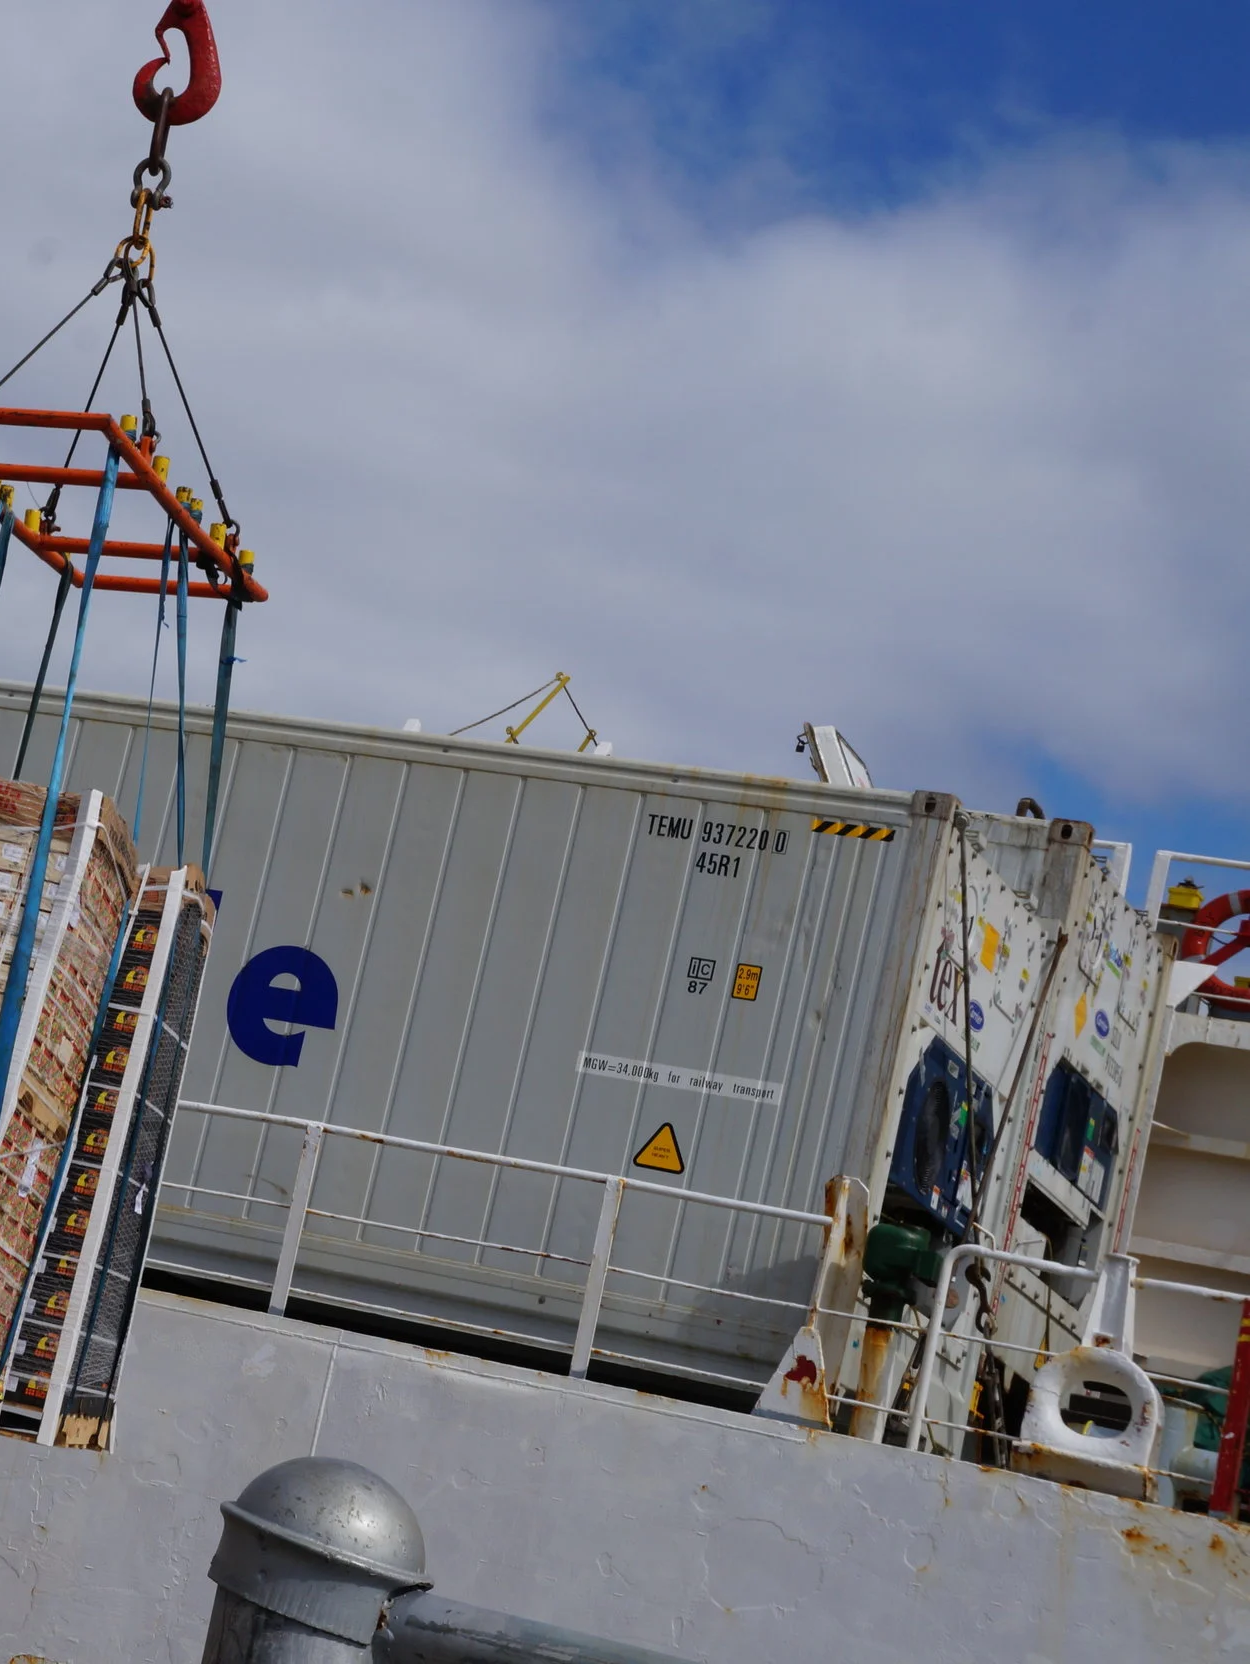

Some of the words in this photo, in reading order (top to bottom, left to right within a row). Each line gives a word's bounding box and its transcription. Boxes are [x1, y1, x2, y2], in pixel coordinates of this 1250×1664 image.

[648, 813, 694, 840] TEMU
[701, 821, 770, 851] 937220
[695, 851, 742, 878] 45R1
[687, 980, 708, 995] 87
[738, 968, 759, 982] 2.9m
[667, 1070, 681, 1084] for
[689, 1075, 724, 1093] railway
[732, 1083, 775, 1100] transport
